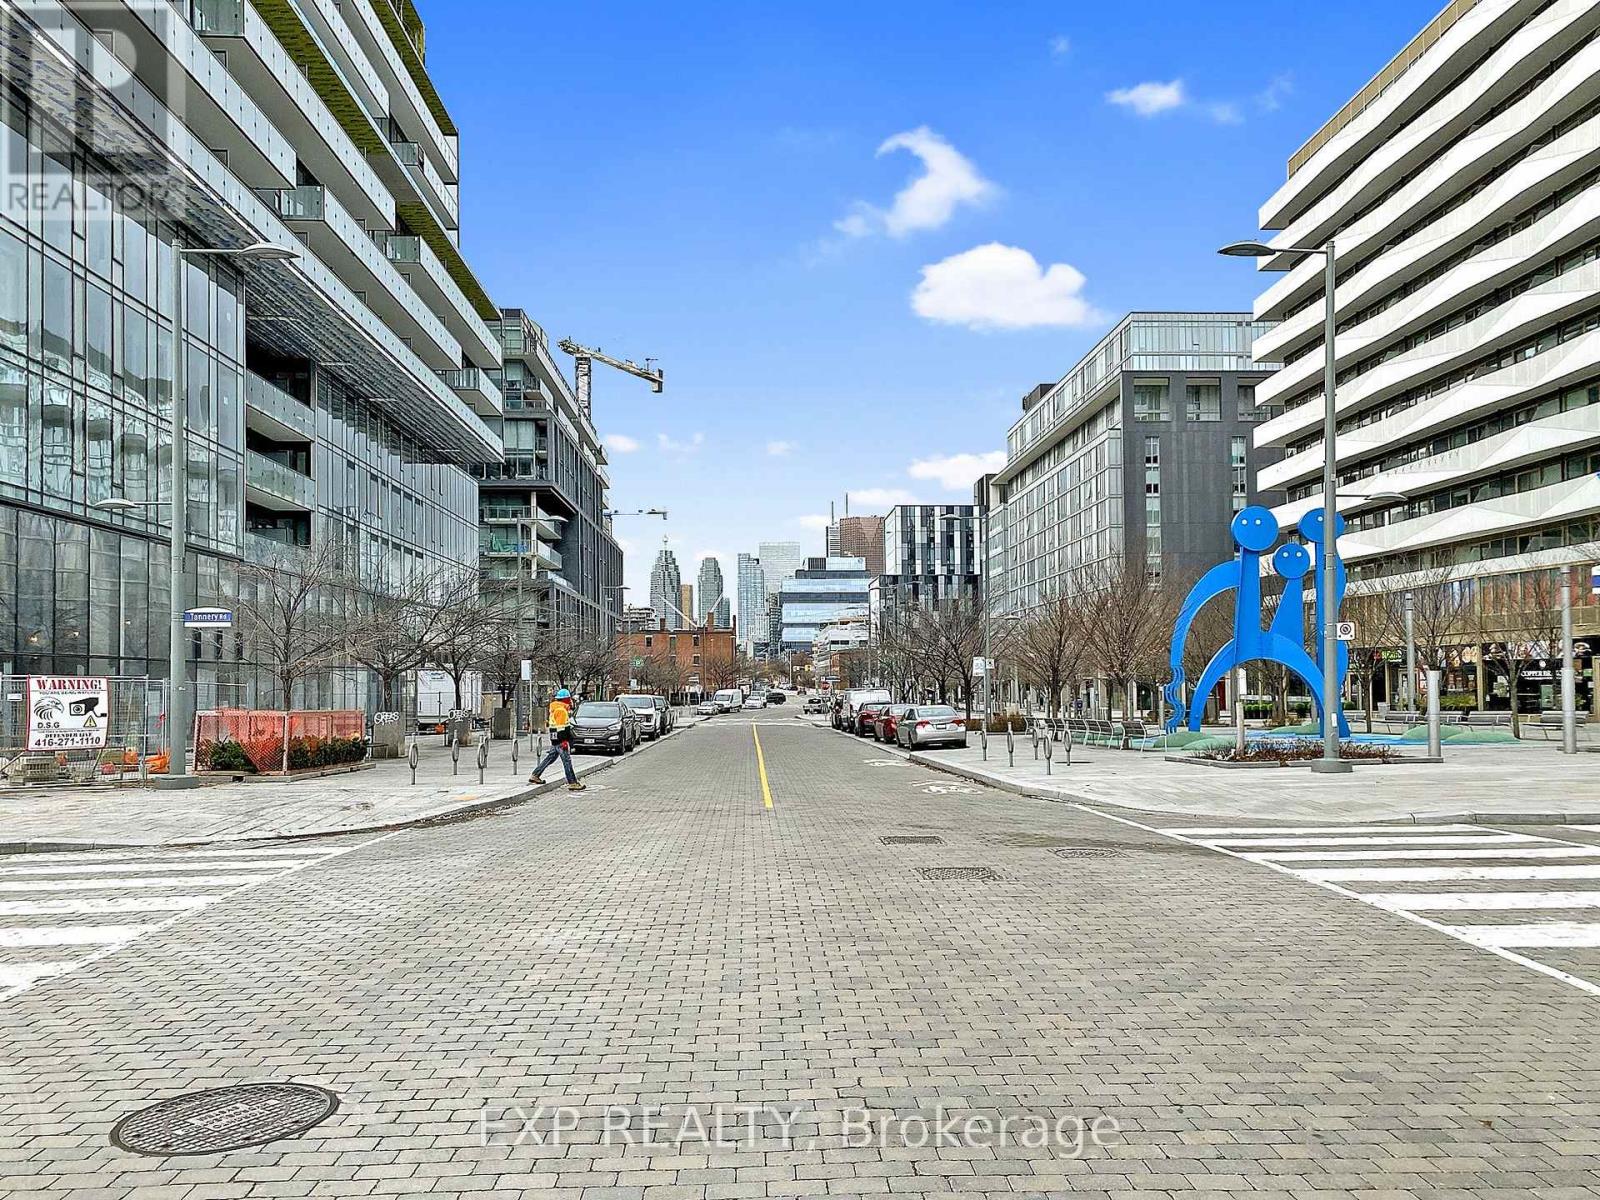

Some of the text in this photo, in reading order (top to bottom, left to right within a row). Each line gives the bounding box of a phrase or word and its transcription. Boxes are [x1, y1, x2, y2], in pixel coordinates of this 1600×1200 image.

[191, 613, 219, 621] Tannery
[37, 679, 102, 690] WARNING!
[37, 721, 60, 729] D.S.G
[35, 736, 101, 747] 416-271-1110
